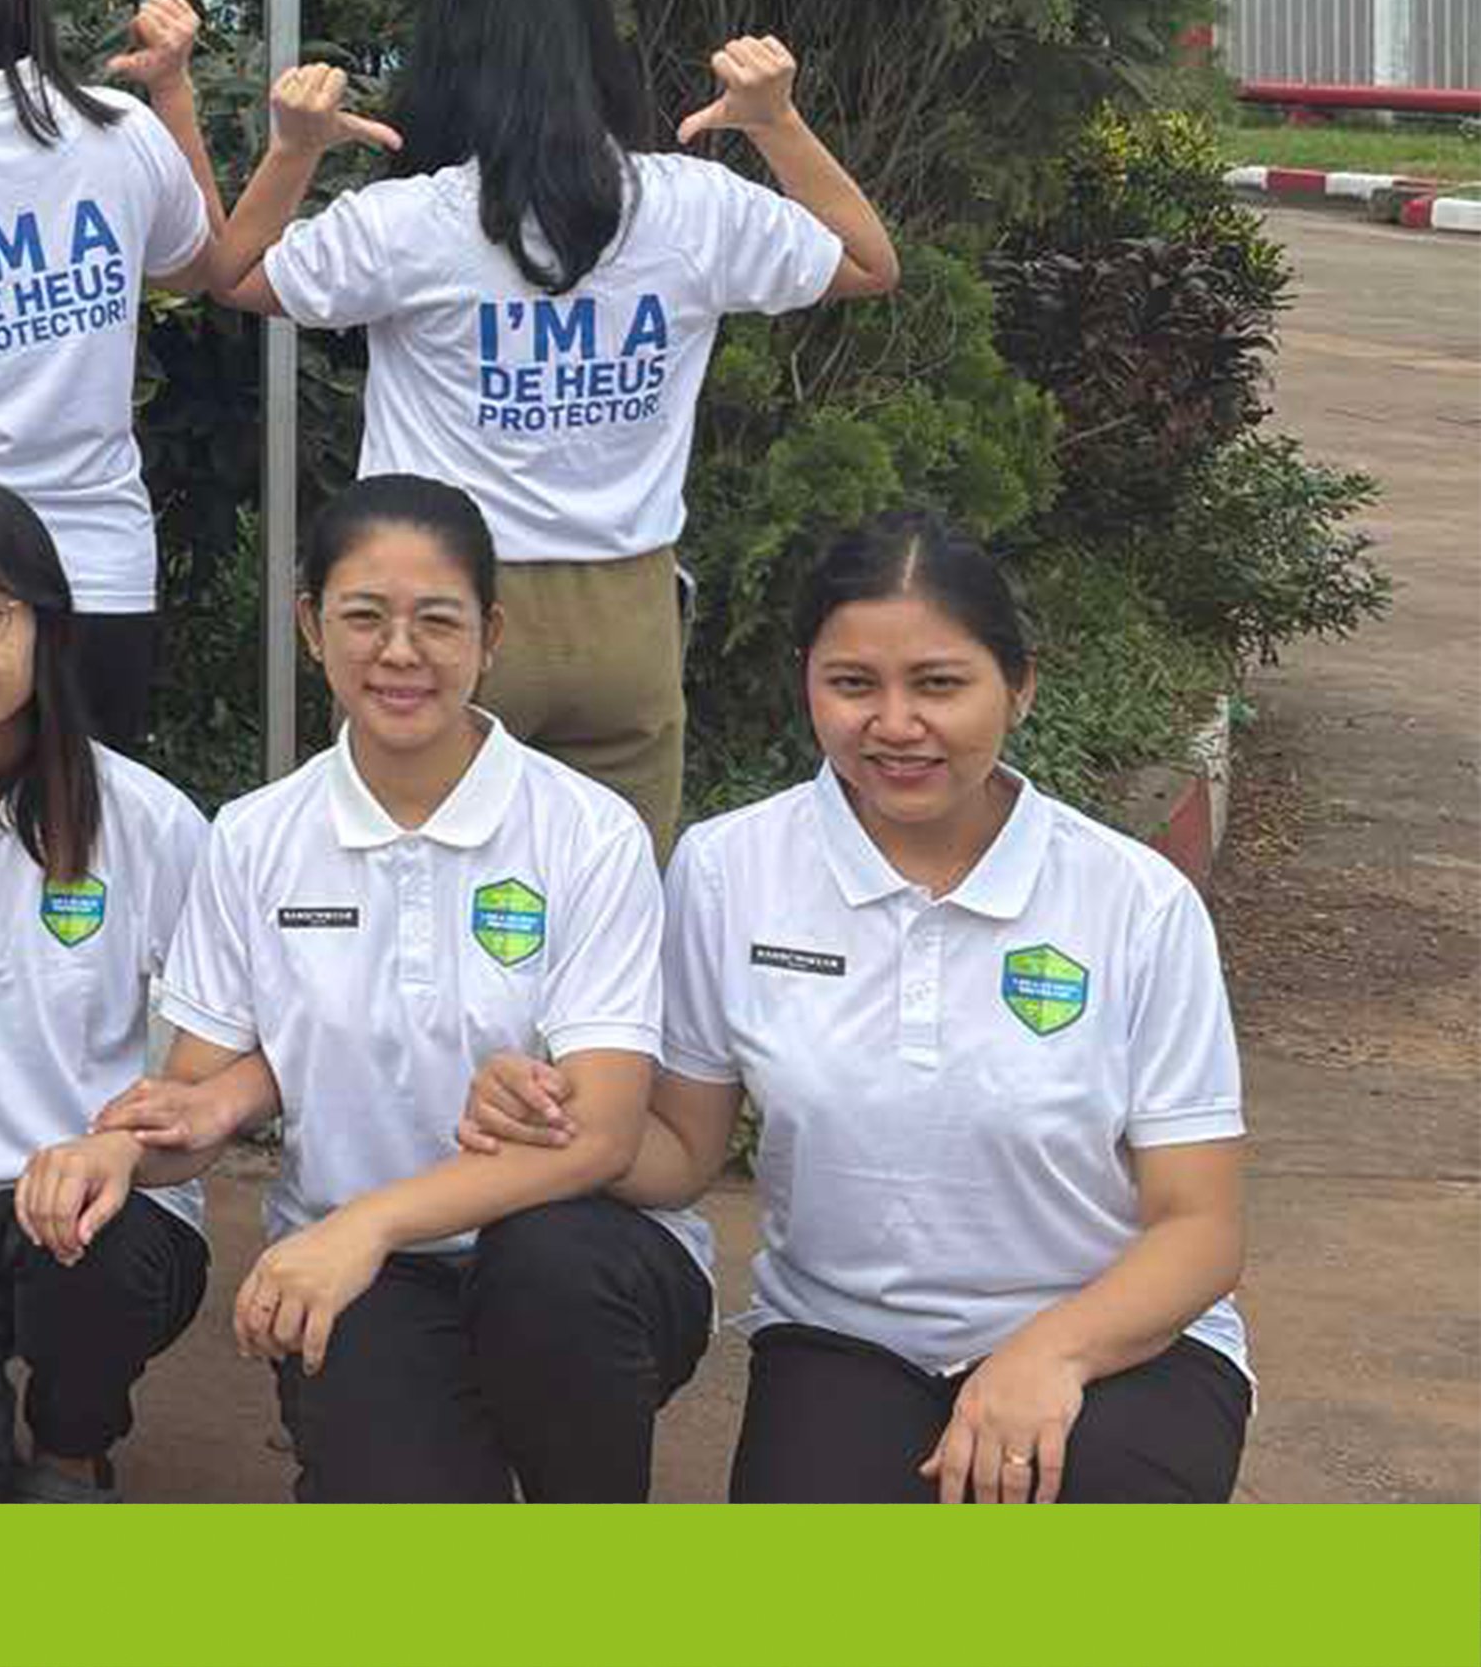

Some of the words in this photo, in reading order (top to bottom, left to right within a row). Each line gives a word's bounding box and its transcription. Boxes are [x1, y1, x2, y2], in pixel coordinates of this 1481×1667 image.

[70, 199, 121, 265] A
[13, 259, 125, 317] HEUS
[479, 298, 596, 362] I'M
[620, 294, 667, 357] A
[480, 365, 544, 403] DE
[556, 355, 665, 400] HEUS
